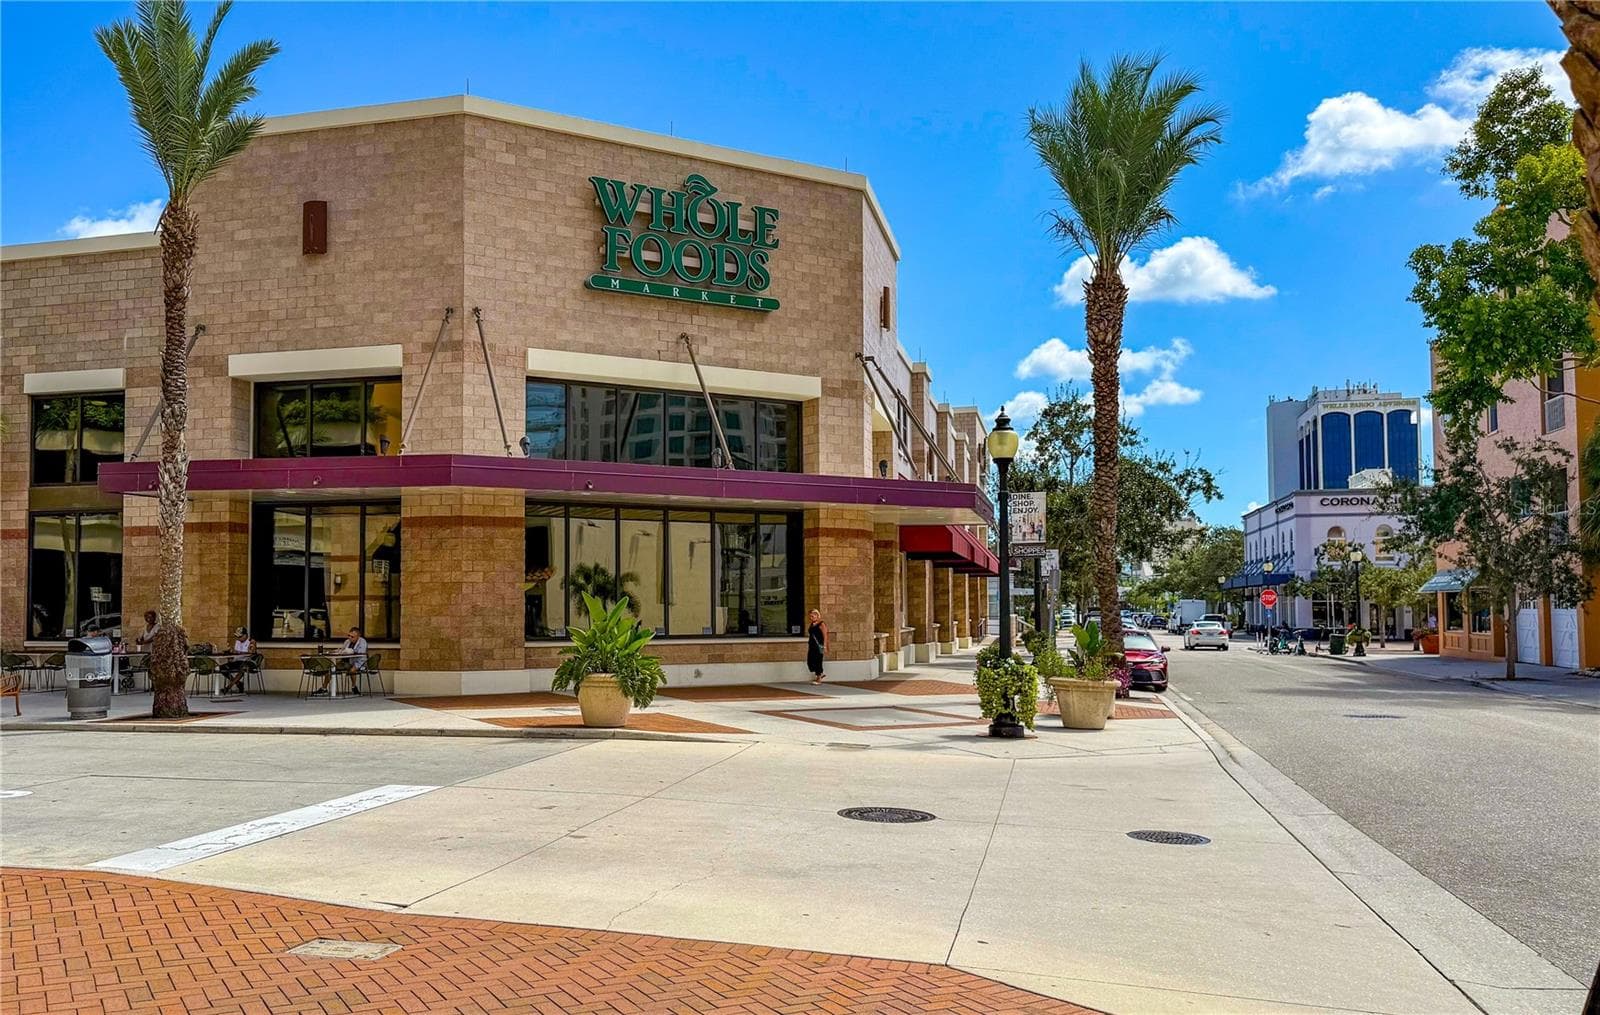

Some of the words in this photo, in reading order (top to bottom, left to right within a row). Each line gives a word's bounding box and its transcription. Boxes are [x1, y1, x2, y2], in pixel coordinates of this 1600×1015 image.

[588, 173, 780, 249] WHOLE
[601, 225, 771, 292] FOODS
[610, 278, 764, 308] MARKET
